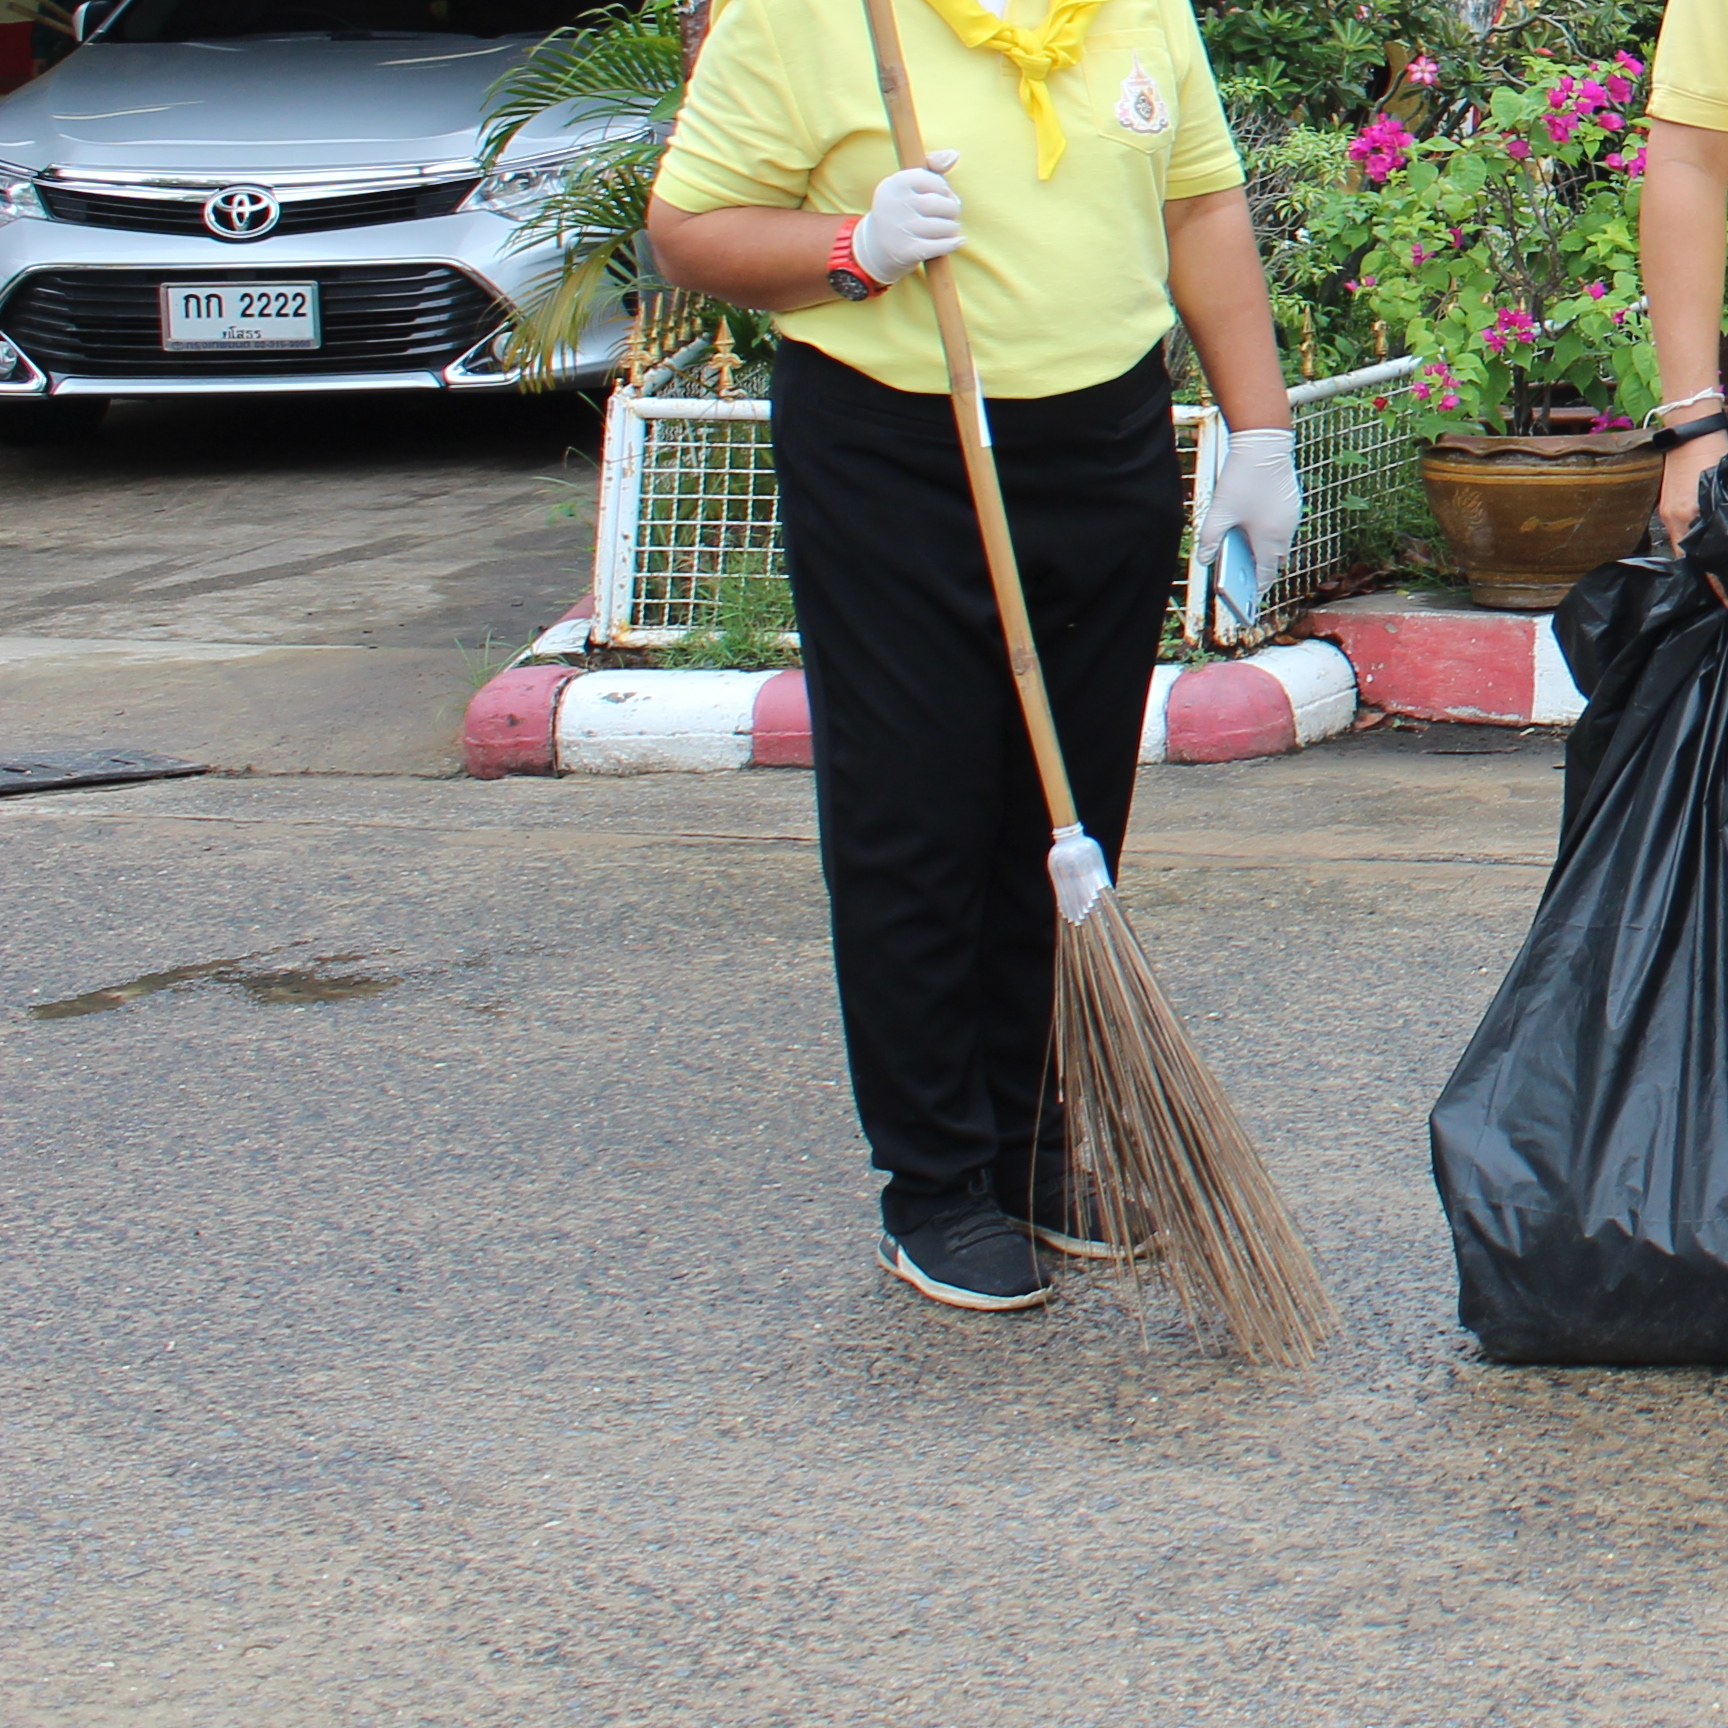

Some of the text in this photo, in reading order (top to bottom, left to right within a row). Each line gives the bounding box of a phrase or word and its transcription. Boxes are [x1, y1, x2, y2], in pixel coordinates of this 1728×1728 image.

[183, 292, 307, 318] กก 2222
[221, 325, 263, 339] ยโสธร
